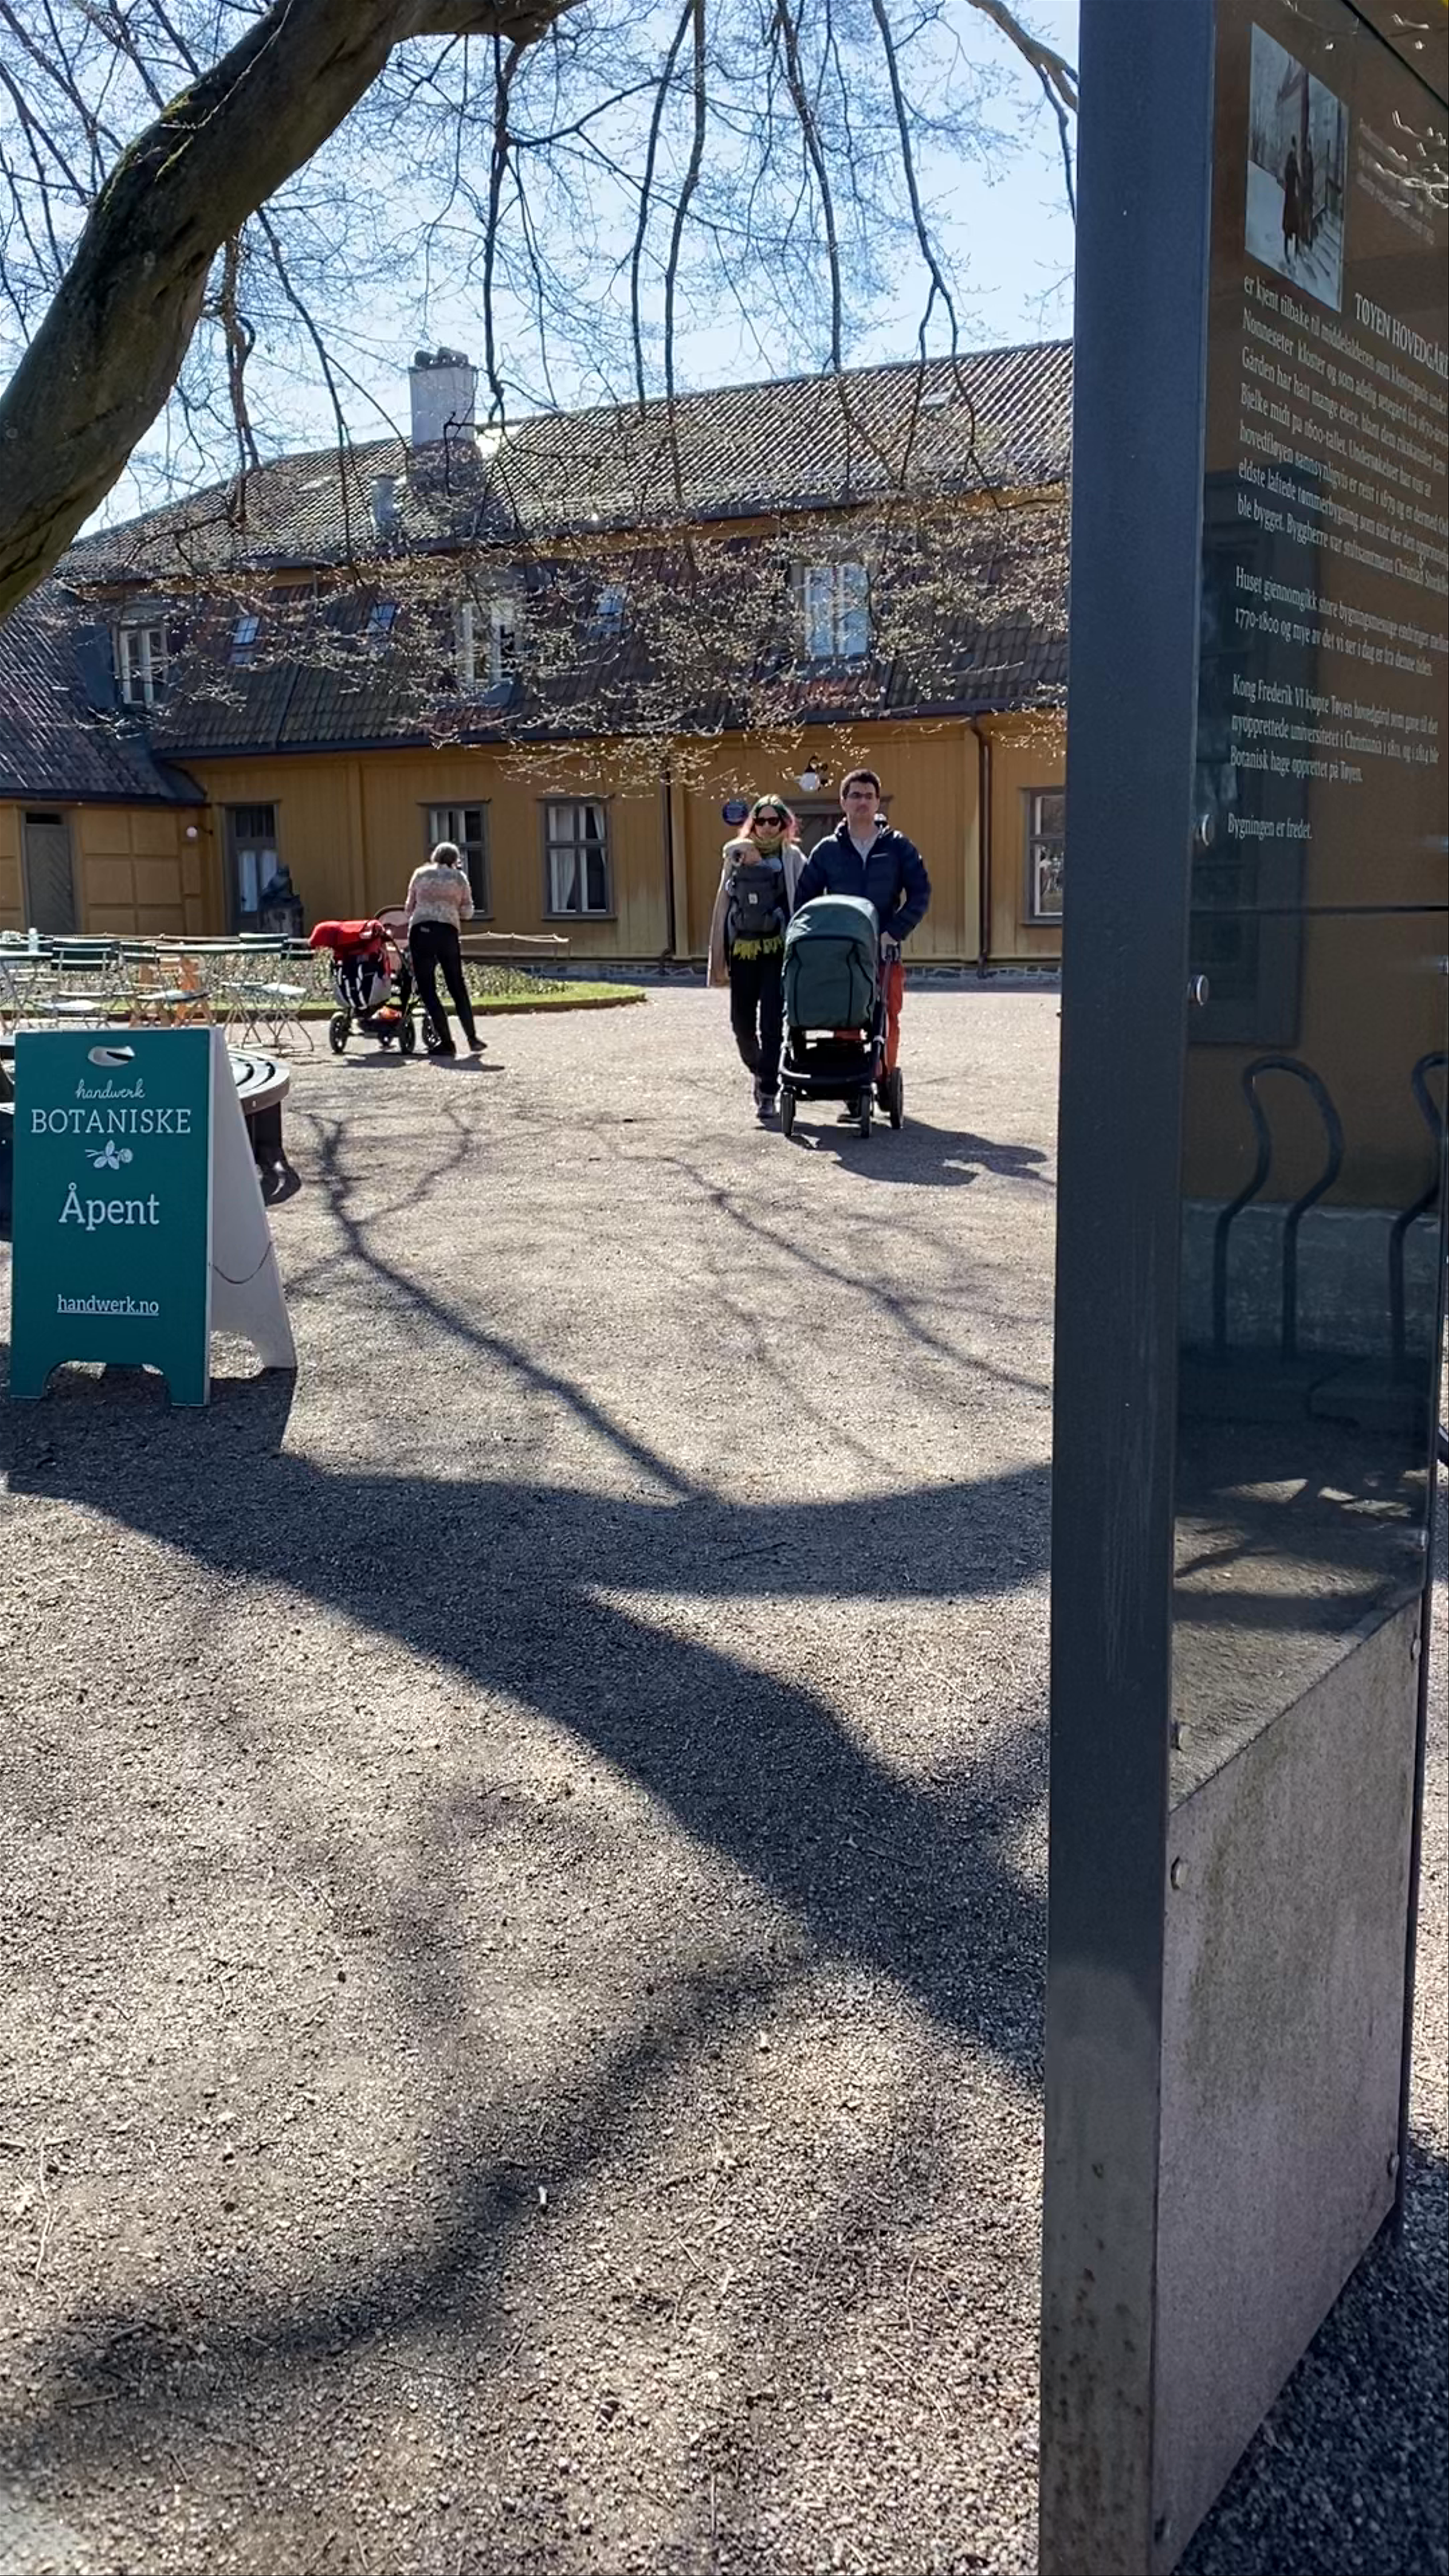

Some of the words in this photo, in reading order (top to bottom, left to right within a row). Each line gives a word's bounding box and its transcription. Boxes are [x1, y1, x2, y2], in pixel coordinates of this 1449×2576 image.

[1244, 275, 1254, 295] er
[1257, 276, 1279, 311] kjent
[1281, 294, 1309, 330] tilbake
[1311, 315, 1320, 337] til
[1355, 293, 1391, 340] TØYEN
[1243, 346, 1274, 384] Gården
[1276, 364, 1292, 391] har
[1294, 373, 1310, 401] hatt
[1297, 339, 1324, 375] kloster
[1326, 364, 1336, 386] og
[1338, 370, 1354, 392] som
[1241, 383, 1268, 416] Bjelke
[1270, 401, 1290, 427] midt
[1239, 457, 1266, 488] eldste
[1267, 468, 1296, 501] laftede
[1349, 478, 1357, 493] er
[1238, 492, 1251, 518] ble
[1254, 498, 1284, 532] bygget.
[1287, 513, 1328, 547] Byggherre
[1235, 565, 1262, 594] Huset
[1263, 576, 1317, 612] gjennomgikk
[1318, 598, 1337, 618] store
[1235, 607, 1279, 634] 1770-1800
[1281, 620, 1291, 642] og
[1293, 624, 1311, 646] mye
[1312, 629, 1321, 644] av
[1322, 628, 1335, 649] det
[1336, 632, 1344, 652] vi
[1345, 639, 1357, 655] ser
[1358, 638, 1361, 656] i
[1362, 639, 1375, 665] dag
[1376, 649, 1383, 662] er
[1233, 674, 1256, 703] Kong
[1258, 679, 1293, 706] Frederik
[1295, 686, 1304, 708] VI
[1305, 689, 1329, 717] kjøpte
[1331, 695, 1352, 720] Tøyen
[1232, 715, 1289, 739] nyopprettede
[1341, 730, 1343, 748] i
[1231, 745, 1269, 770] Botanisk
[1271, 751, 1290, 777] hage
[1291, 758, 1328, 779] opprettet
[1228, 812, 1274, 841] Bygningen
[1276, 821, 1285, 837] er
[1287, 817, 1312, 839] fredet.
[76, 1078, 145, 1100] handwerk
[31, 1109, 191, 1134] BOTANISKE
[59, 1182, 160, 1231] Åpent
[57, 1294, 159, 1313] handwerk.no
